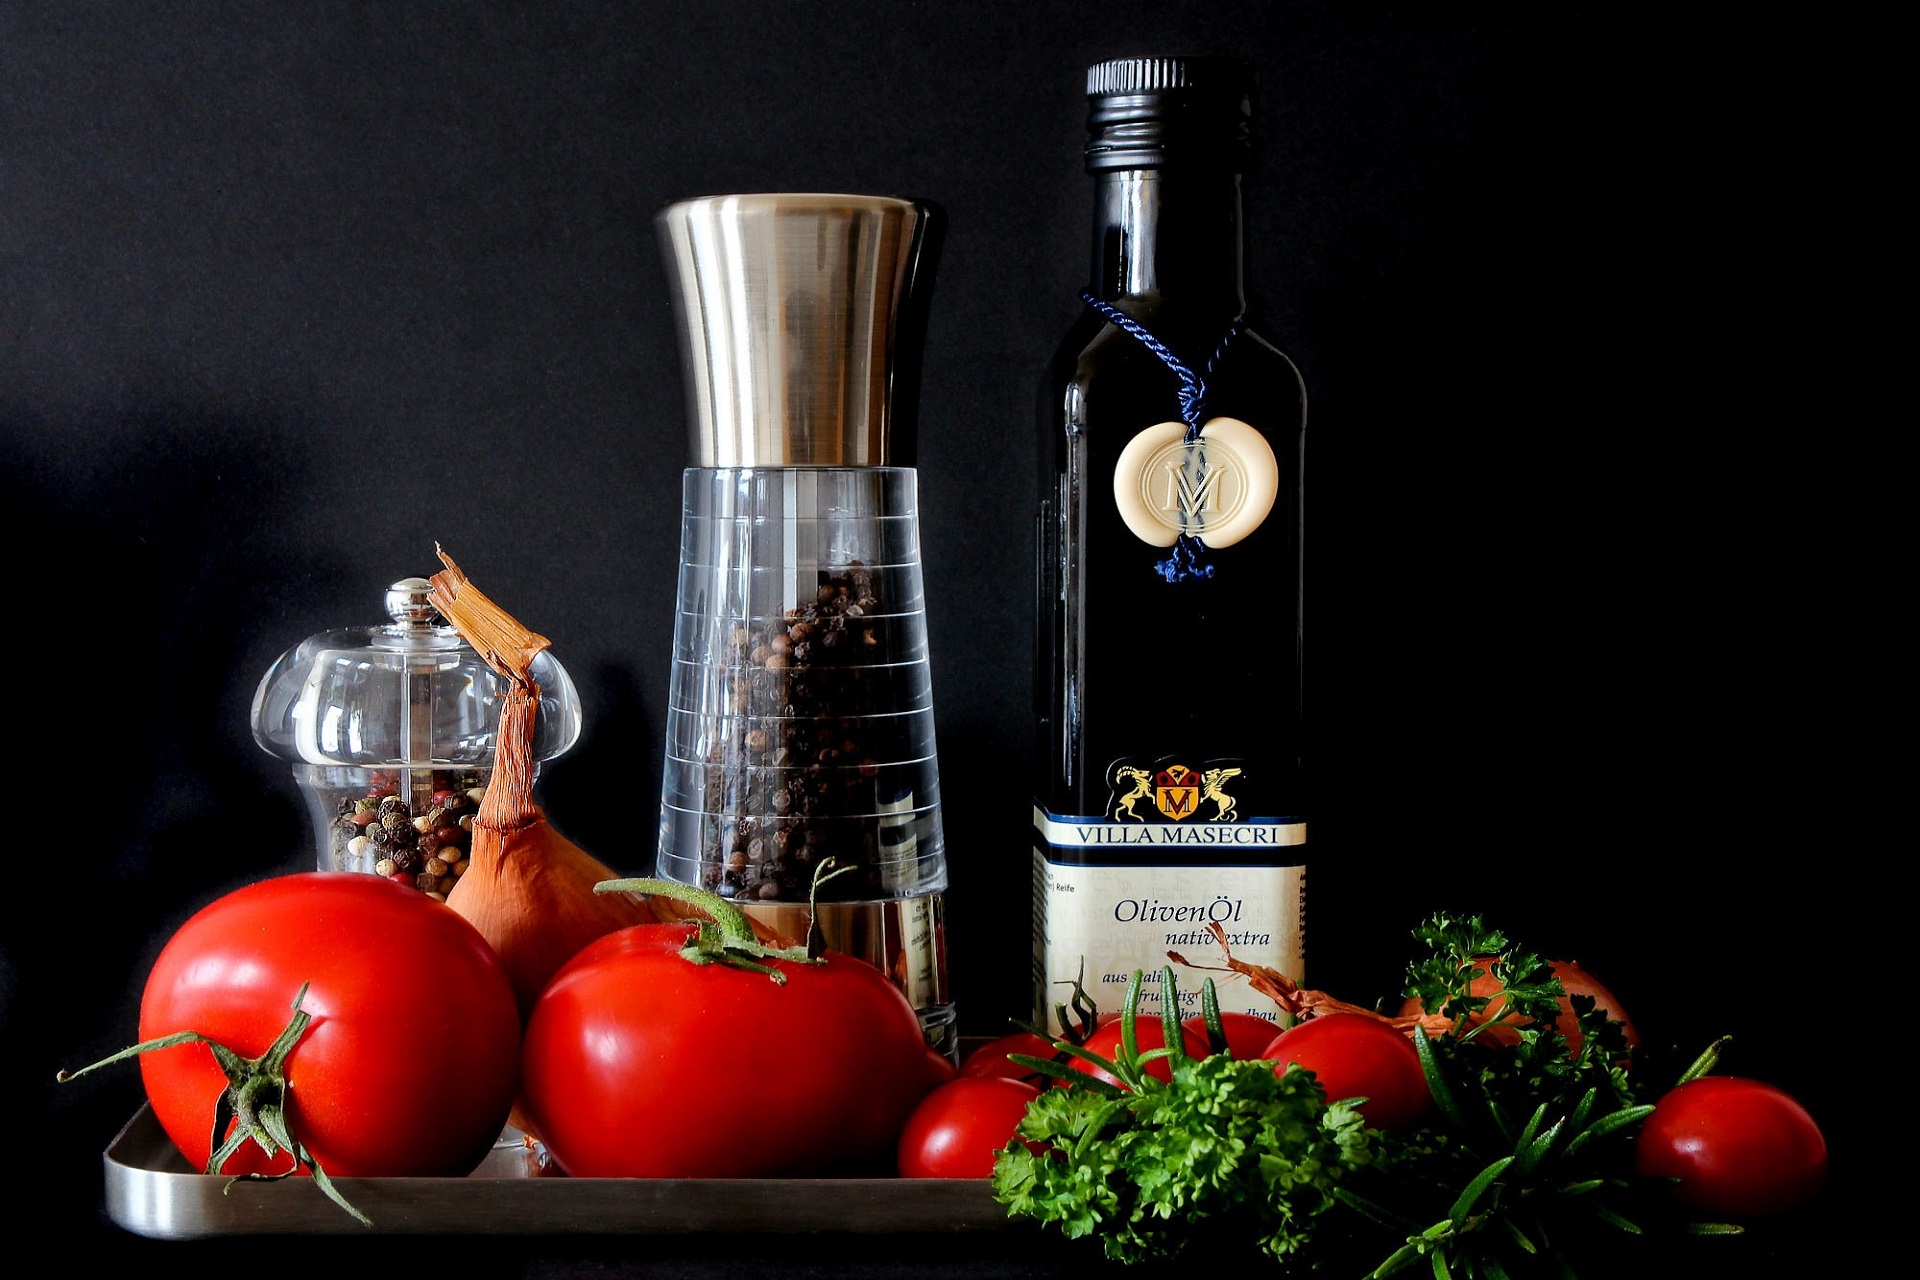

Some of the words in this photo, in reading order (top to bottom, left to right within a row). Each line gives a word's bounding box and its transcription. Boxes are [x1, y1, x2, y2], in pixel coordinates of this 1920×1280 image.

[1076, 827, 1155, 844] VILLA
[1161, 827, 1278, 844] MASECRI
[1056, 883, 1075, 893] Reife
[1114, 895, 1243, 923] OlivenÖl
[1165, 929, 1215, 946] nativ
[1102, 973, 1128, 983] aus
